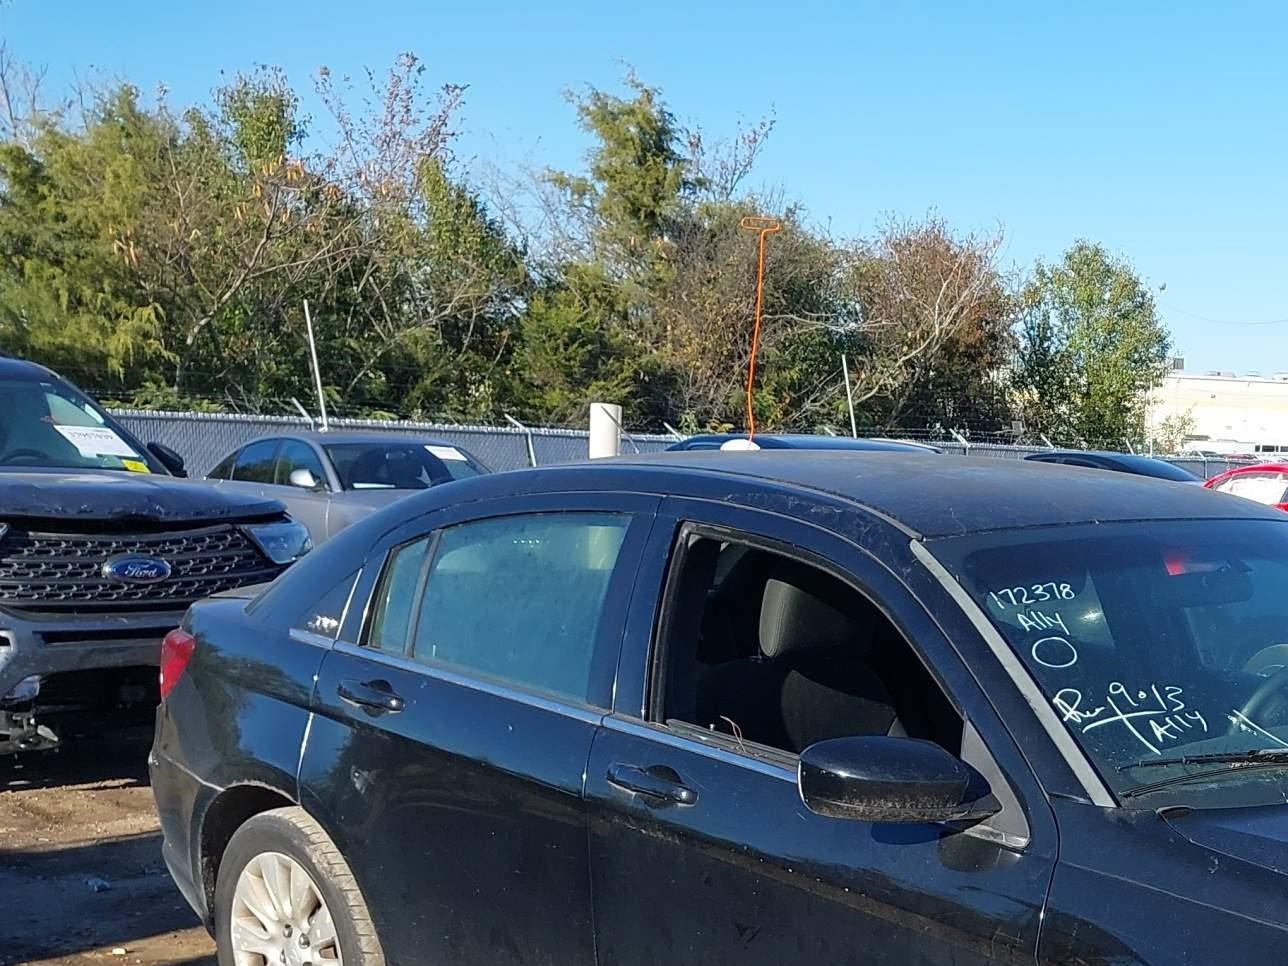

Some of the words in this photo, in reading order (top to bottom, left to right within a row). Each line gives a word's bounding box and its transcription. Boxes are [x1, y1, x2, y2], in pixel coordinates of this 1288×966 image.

[125, 564, 158, 577] Ford
[990, 582, 1075, 609] 172378
[1016, 610, 1070, 636] Ally
